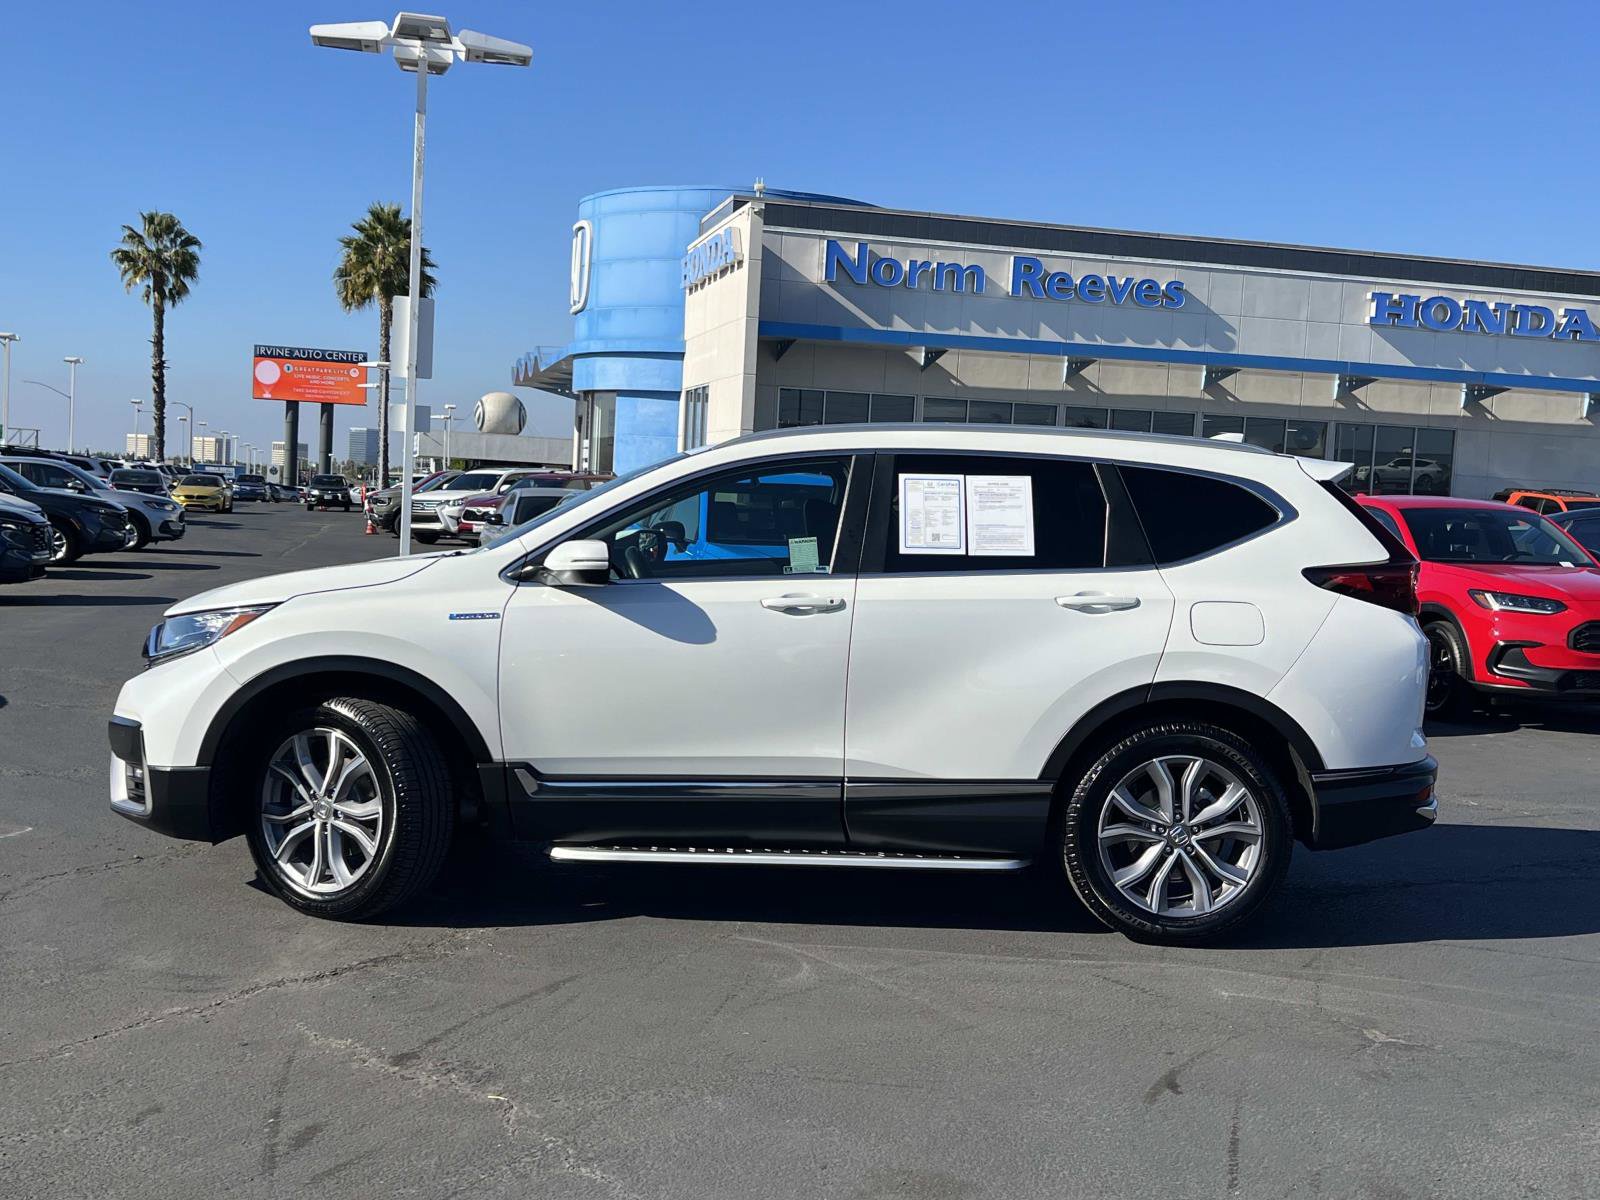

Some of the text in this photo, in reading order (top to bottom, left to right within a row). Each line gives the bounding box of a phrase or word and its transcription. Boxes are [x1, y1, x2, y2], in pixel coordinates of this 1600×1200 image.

[680, 227, 741, 289] HONDA
[823, 239, 1600, 341] Norm Reeves HONDA
[256, 346, 364, 362] IRVINE AUTO CENTER
